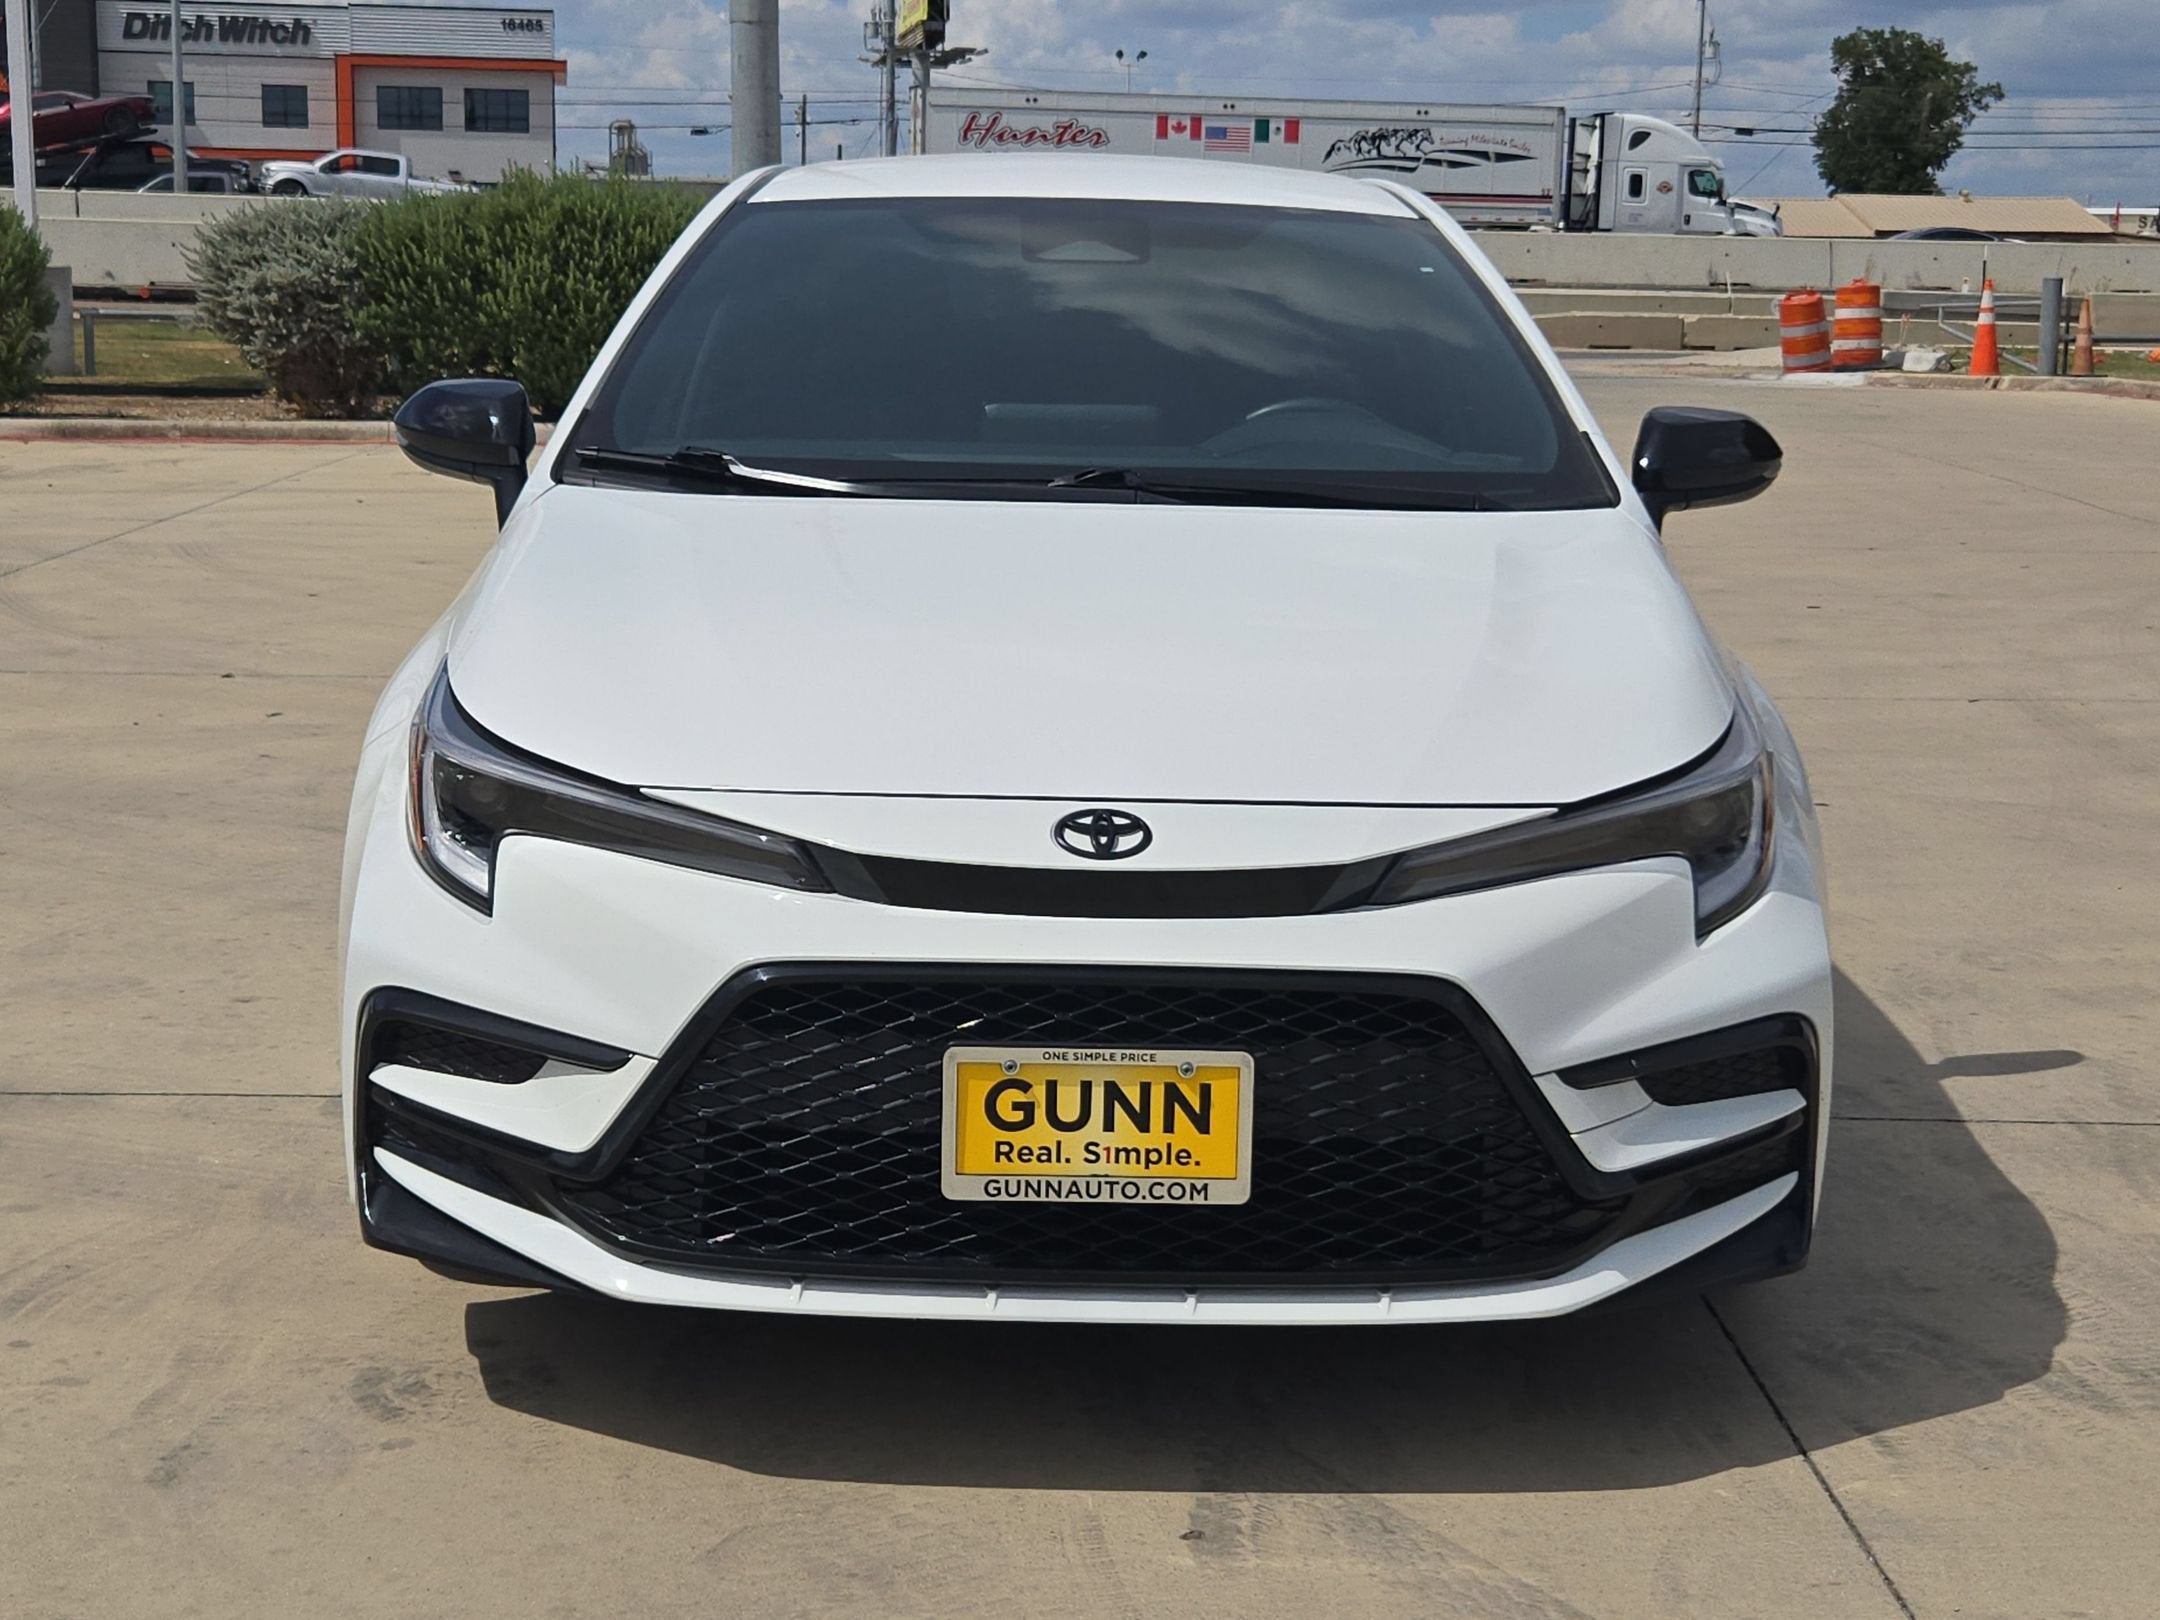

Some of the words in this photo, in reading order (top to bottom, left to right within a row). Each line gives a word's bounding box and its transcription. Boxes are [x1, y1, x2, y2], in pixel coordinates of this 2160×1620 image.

[123, 12, 213, 42] Ditch
[218, 16, 311, 45] Witch
[501, 18, 543, 32] 16465
[960, 111, 1109, 148] Hunter
[1042, 1051, 1069, 1061] ONE
[1073, 1052, 1116, 1062] SIMPLE
[1120, 1053, 1157, 1062] PRICE
[984, 1078, 1211, 1135] GUNN
[994, 1140, 1071, 1163] Real.
[984, 1179, 1209, 1201] GUNNAUTO.COM
